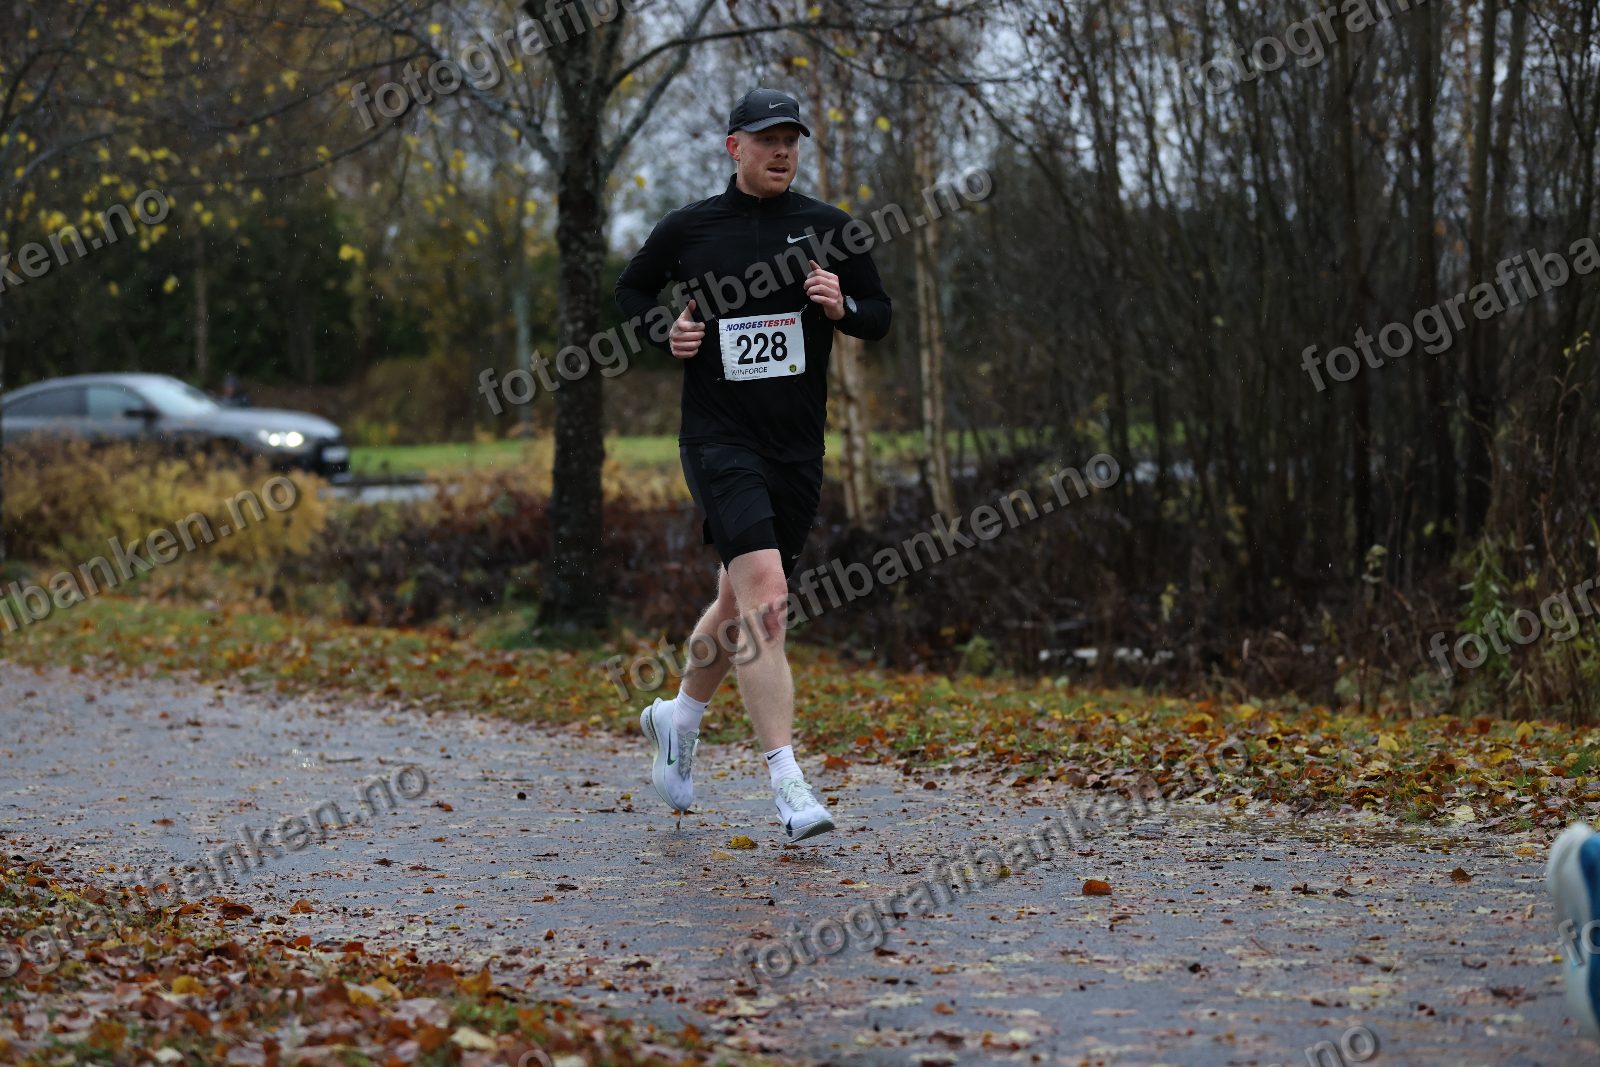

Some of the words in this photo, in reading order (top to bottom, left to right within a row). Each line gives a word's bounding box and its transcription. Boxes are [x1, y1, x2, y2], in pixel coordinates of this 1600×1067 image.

[726, 318, 796, 331] NORGESTESTEN
[736, 331, 788, 365] 228
[731, 366, 768, 376] WINFORCE
